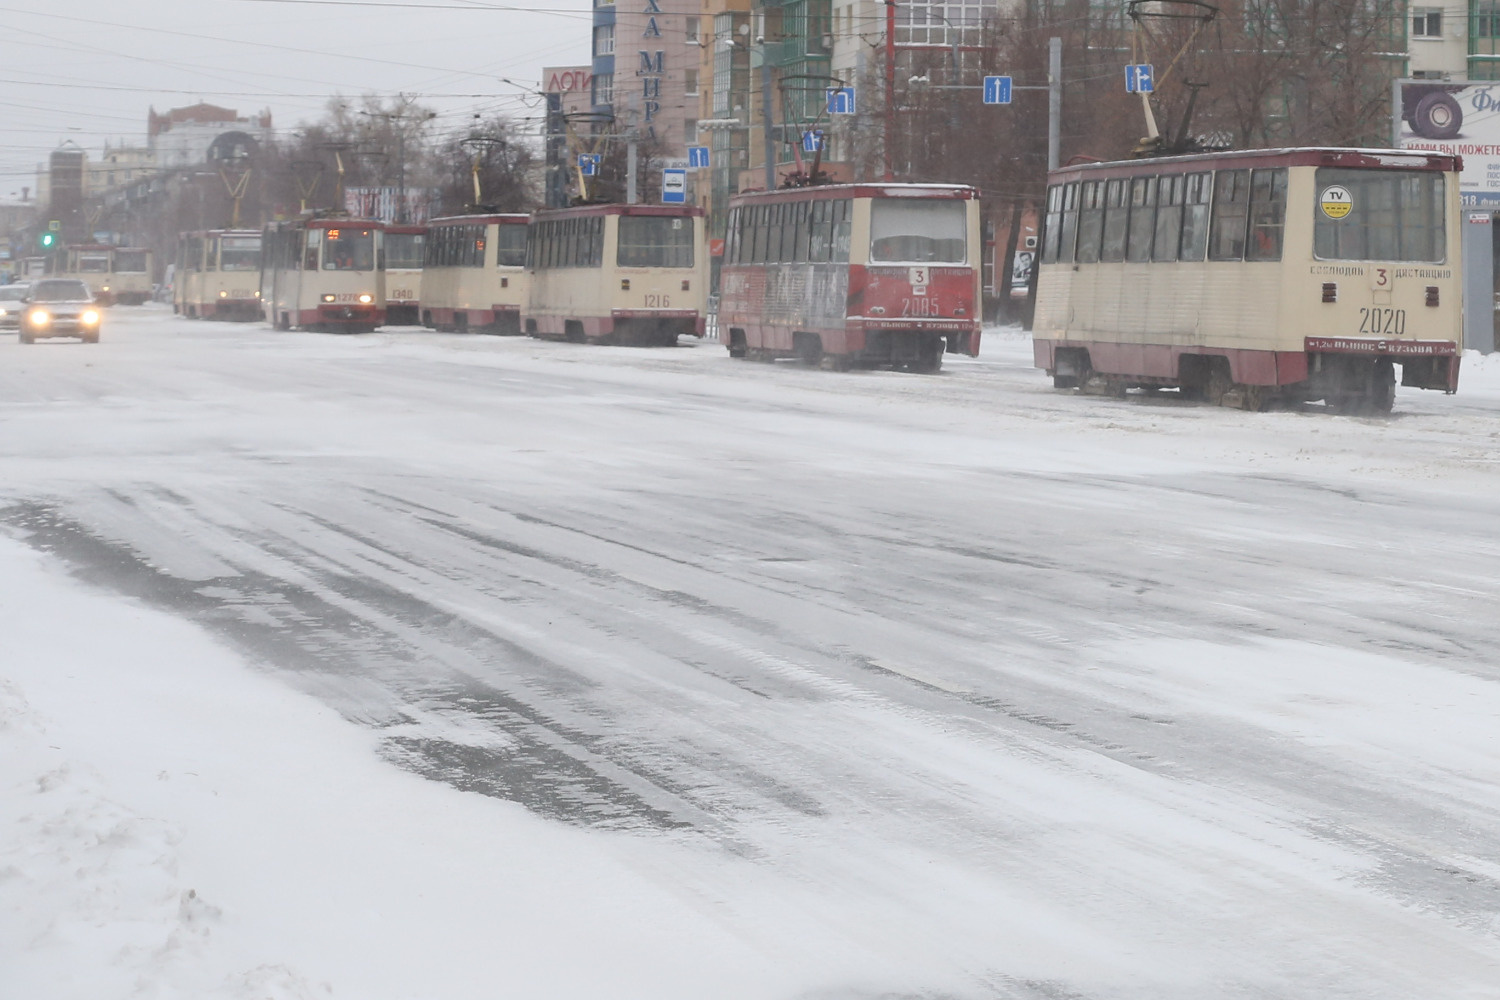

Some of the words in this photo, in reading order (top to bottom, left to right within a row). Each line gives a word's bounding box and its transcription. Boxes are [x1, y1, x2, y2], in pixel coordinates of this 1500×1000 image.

[1329, 191, 1343, 200] TV
[915, 270, 924, 283] 3
[1376, 268, 1387, 286] 3
[644, 294, 670, 308] 1216
[1359, 307, 1406, 334] 2020
